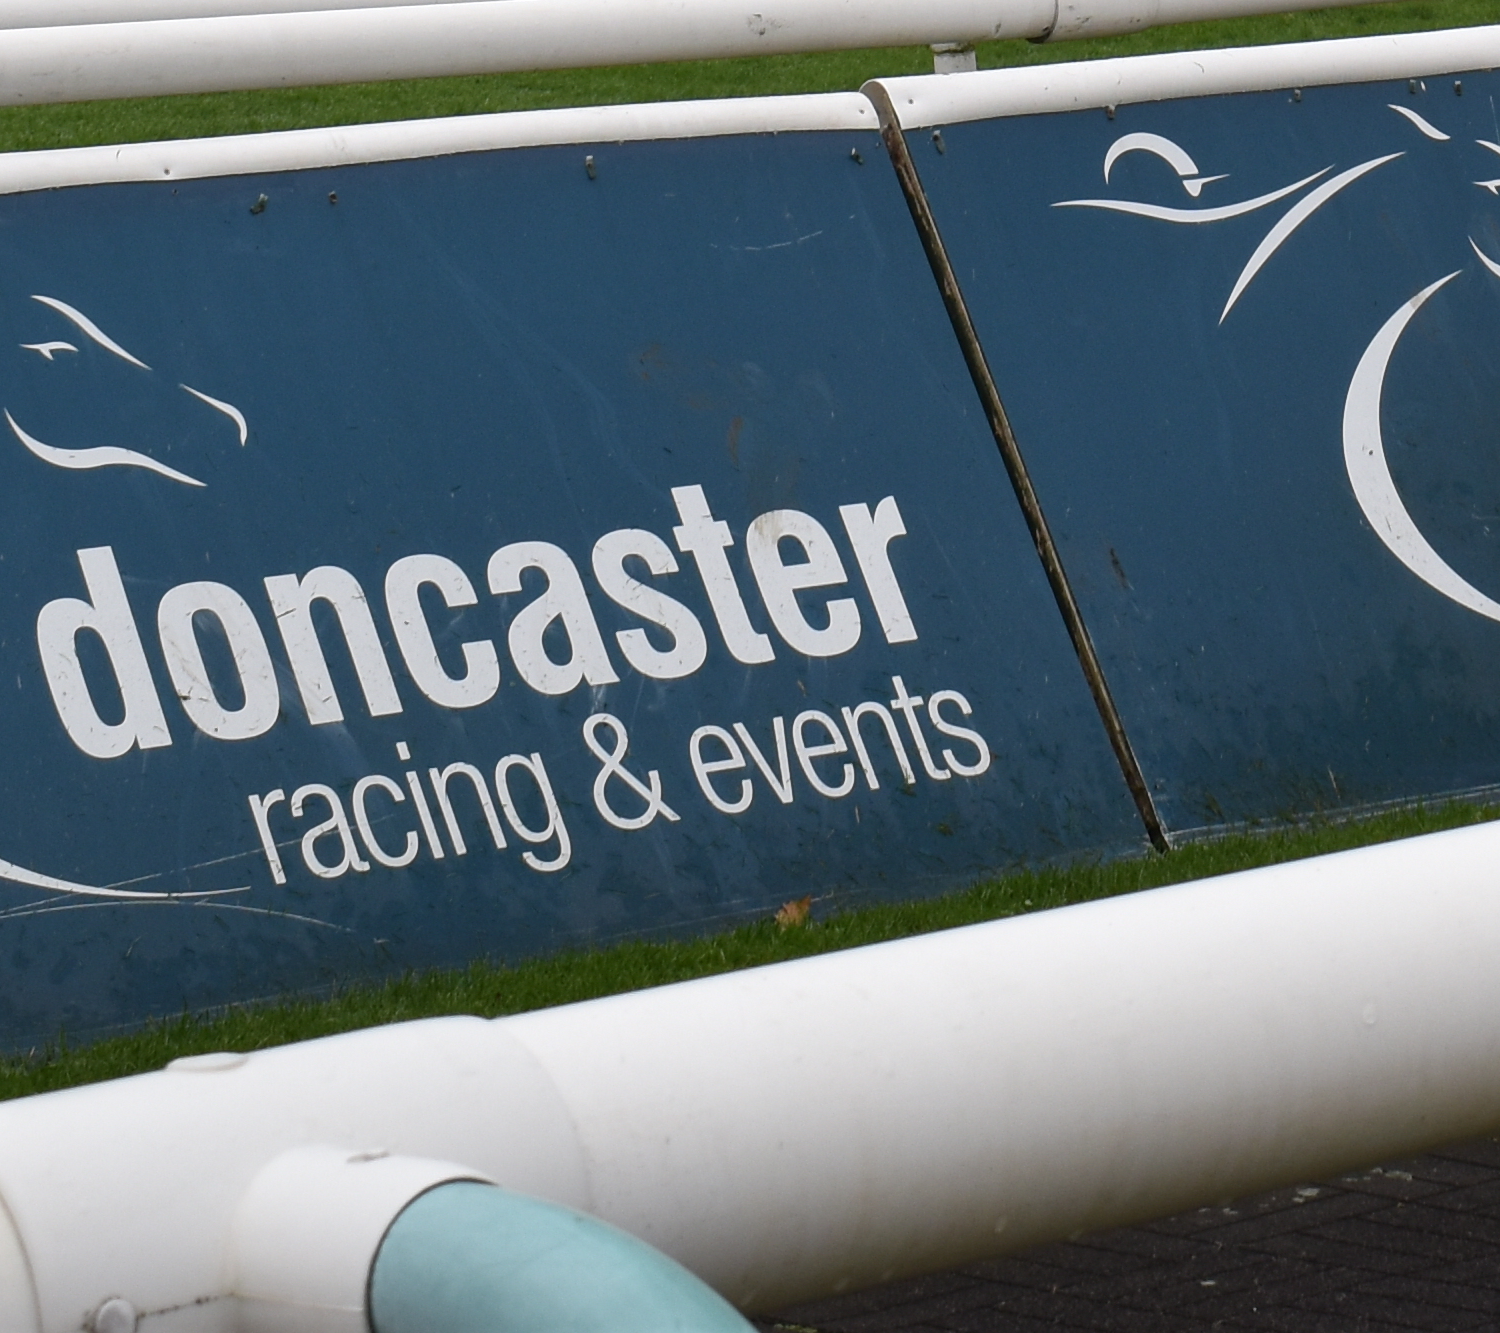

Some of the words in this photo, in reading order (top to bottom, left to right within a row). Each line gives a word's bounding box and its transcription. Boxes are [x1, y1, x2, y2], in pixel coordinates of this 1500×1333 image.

[36, 483, 918, 760] doncaster
[249, 735, 577, 887] racing
[590, 712, 681, 833] &
[689, 673, 992, 816] events
